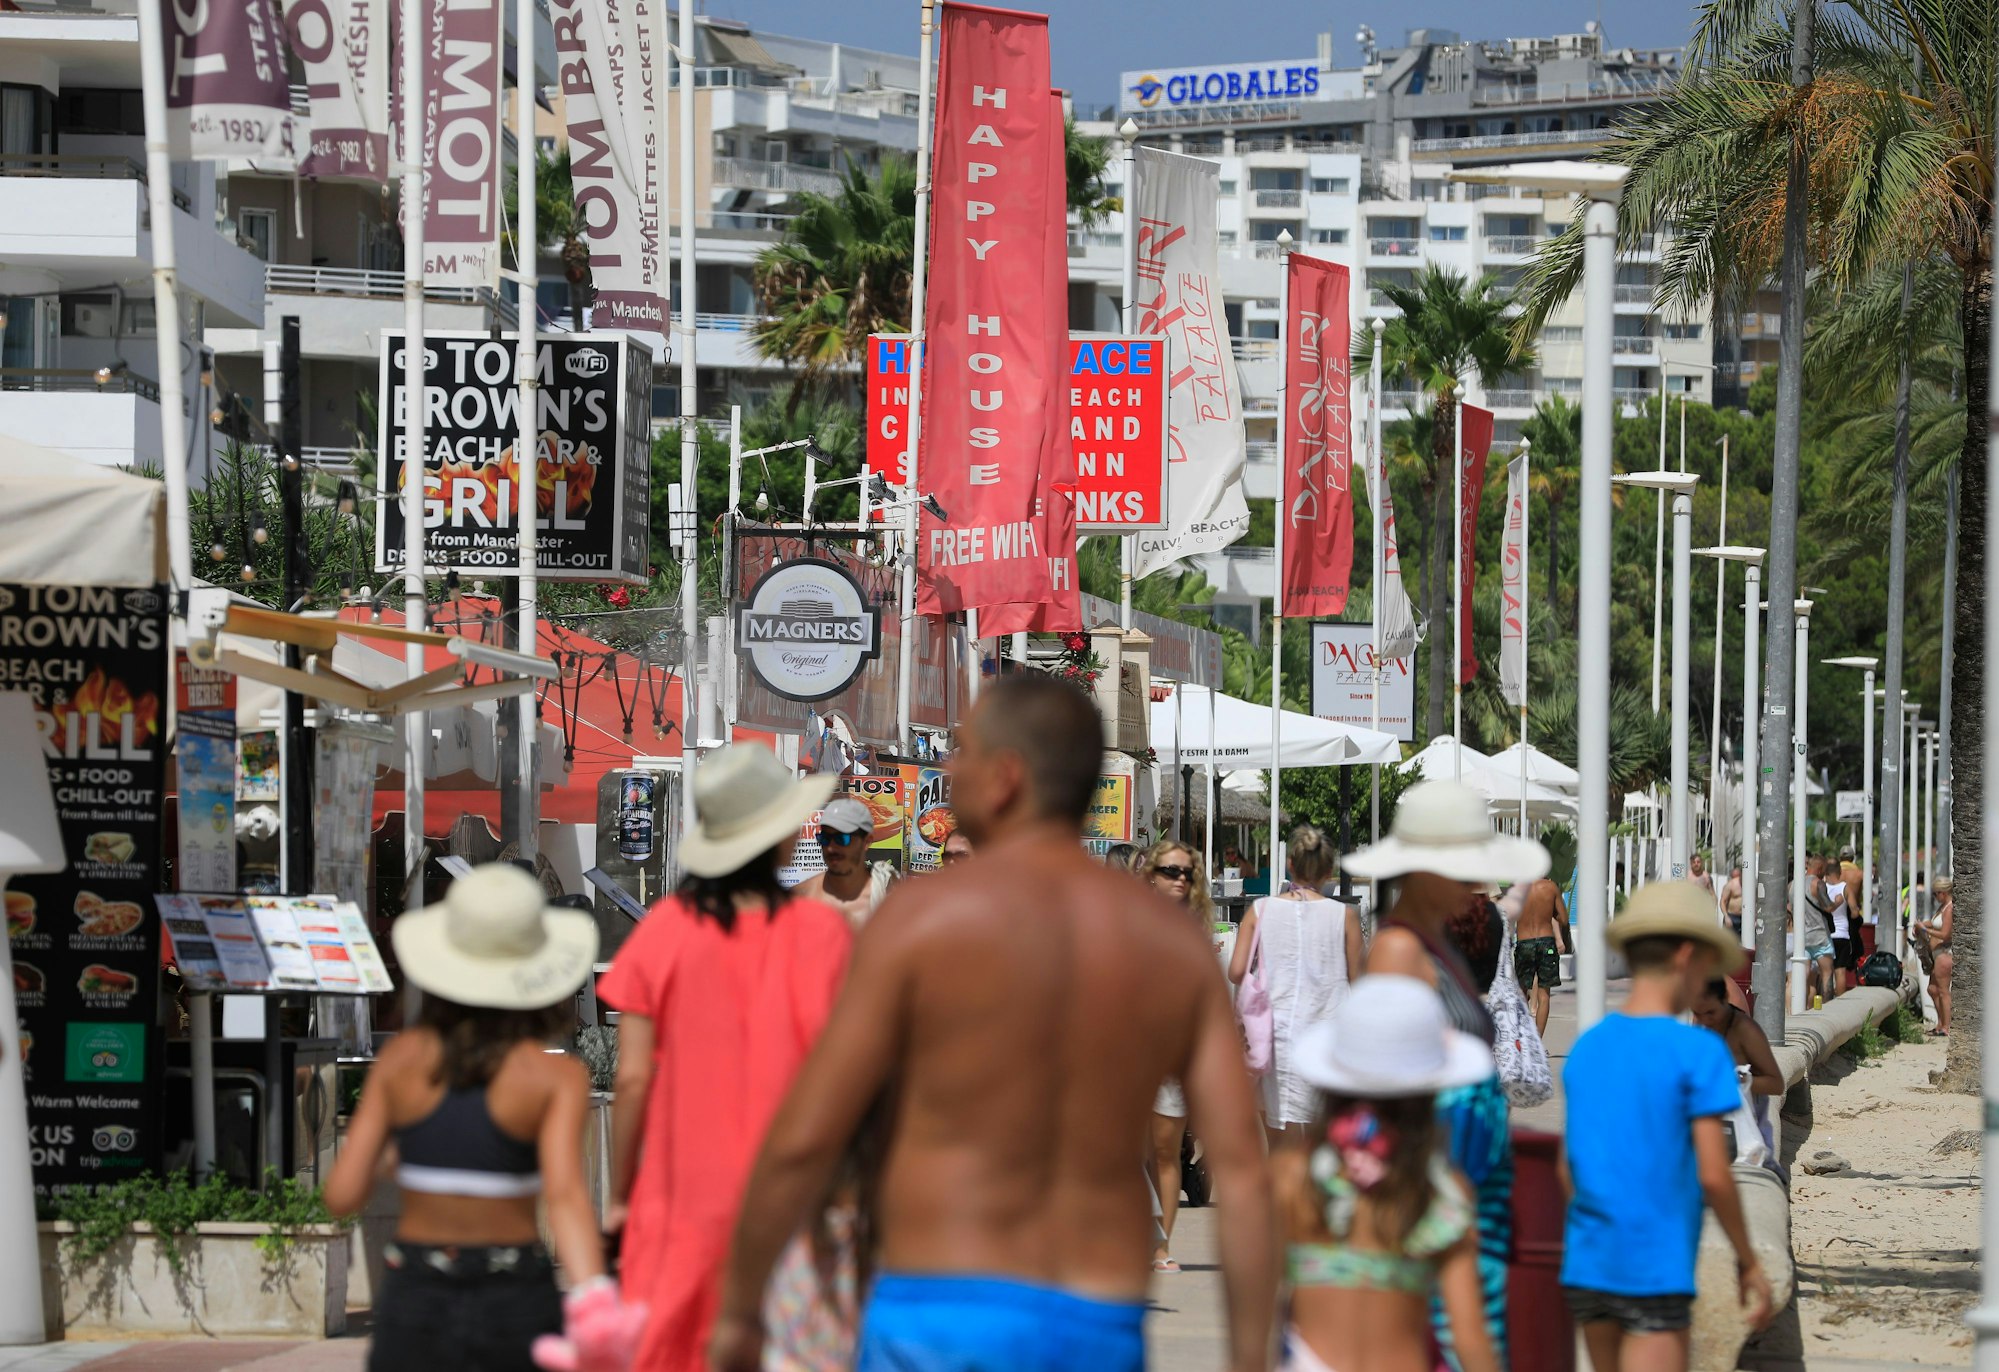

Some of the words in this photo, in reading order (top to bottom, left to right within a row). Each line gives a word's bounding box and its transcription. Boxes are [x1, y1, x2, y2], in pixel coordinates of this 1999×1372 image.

[636, 23, 656, 114] JACKET
[1166, 65, 1321, 105] GLOBALES
[218, 118, 265, 144] 1982
[965, 85, 1007, 261] HAPPY
[1071, 342, 1152, 375] ACE
[1182, 271, 1227, 422] PALACE
[446, 341, 554, 386] TOM
[967, 314, 1004, 486] HOUSE
[1070, 387, 1142, 407] EACH
[1290, 310, 1331, 531] DAIQUIRI
[1326, 357, 1347, 493] PALACE
[585, 445, 603, 465] &
[1190, 516, 1241, 535] BEACH
[431, 531, 469, 547] from
[473, 533, 564, 549] Manchster
[929, 526, 984, 568] FREE
[991, 520, 1039, 560] WIFI
[460, 551, 507, 566] FOOD
[537, 553, 608, 568] HILL-OUT
[22, 583, 118, 614] TOM
[749, 618, 865, 642] MAGNERS
[781, 651, 829, 670] Original
[1335, 672, 1392, 684] PALAE
[1349, 692, 1363, 701] Since
[36, 710, 154, 762] RILL
[1186, 748, 1223, 757] ESTRELA
[1225, 747, 1249, 756] DAMM
[78, 768, 134, 785] FOOD
[56, 788, 156, 805] CHILL-OUT
[31, 1095, 74, 1109] Warm
[76, 1095, 140, 1109] Welcome
[43, 1125, 75, 1145] US
